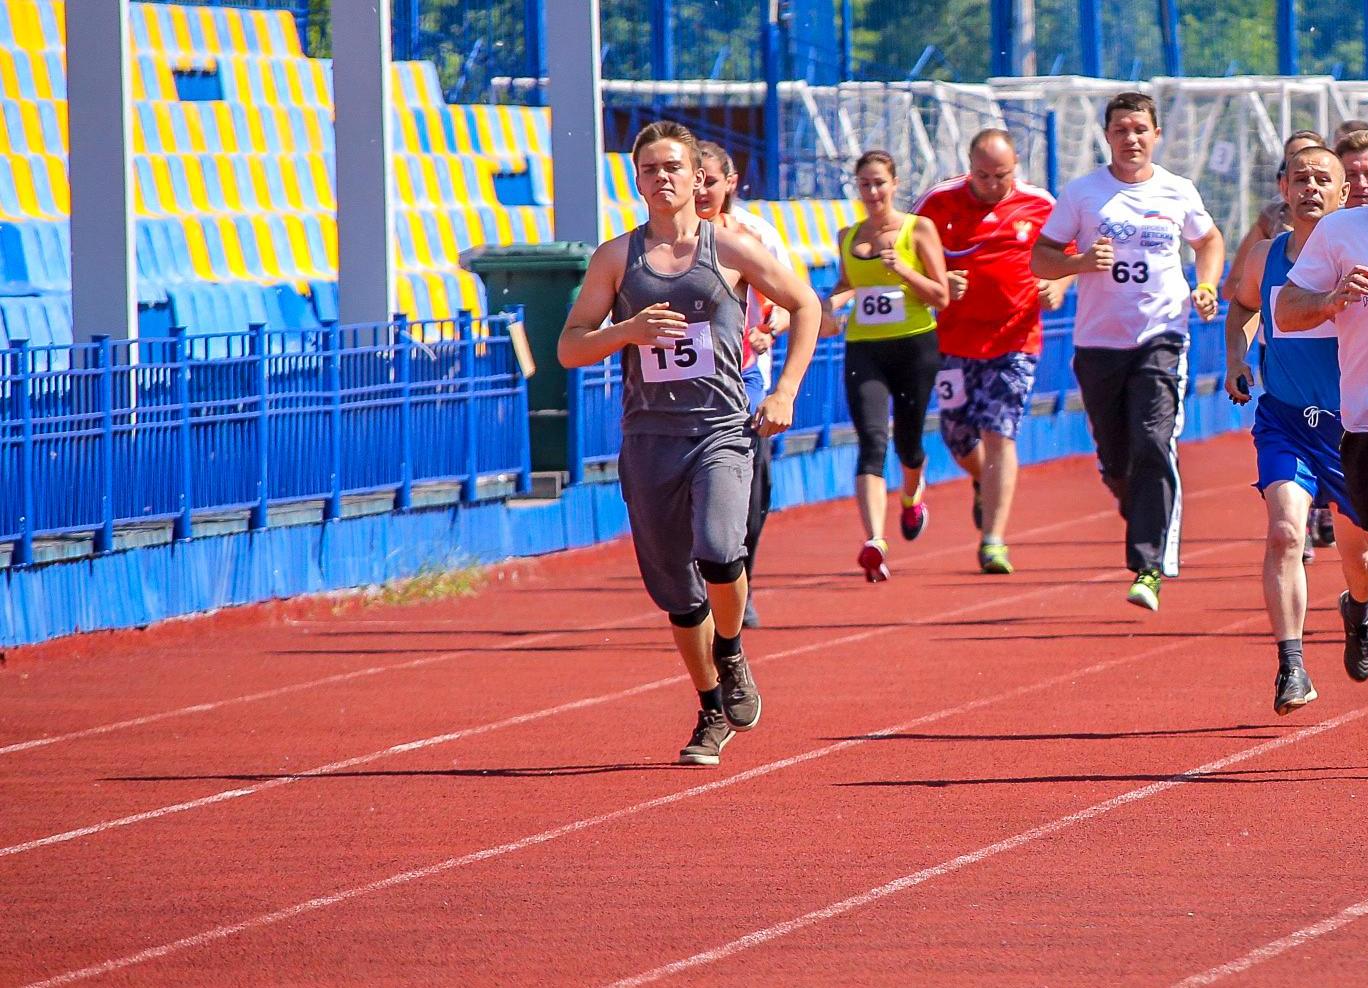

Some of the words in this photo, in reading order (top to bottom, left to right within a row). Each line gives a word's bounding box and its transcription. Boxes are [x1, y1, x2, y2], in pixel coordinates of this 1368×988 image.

[1112, 261, 1149, 284] 63
[863, 295, 892, 316] 68
[651, 338, 698, 370] 15
